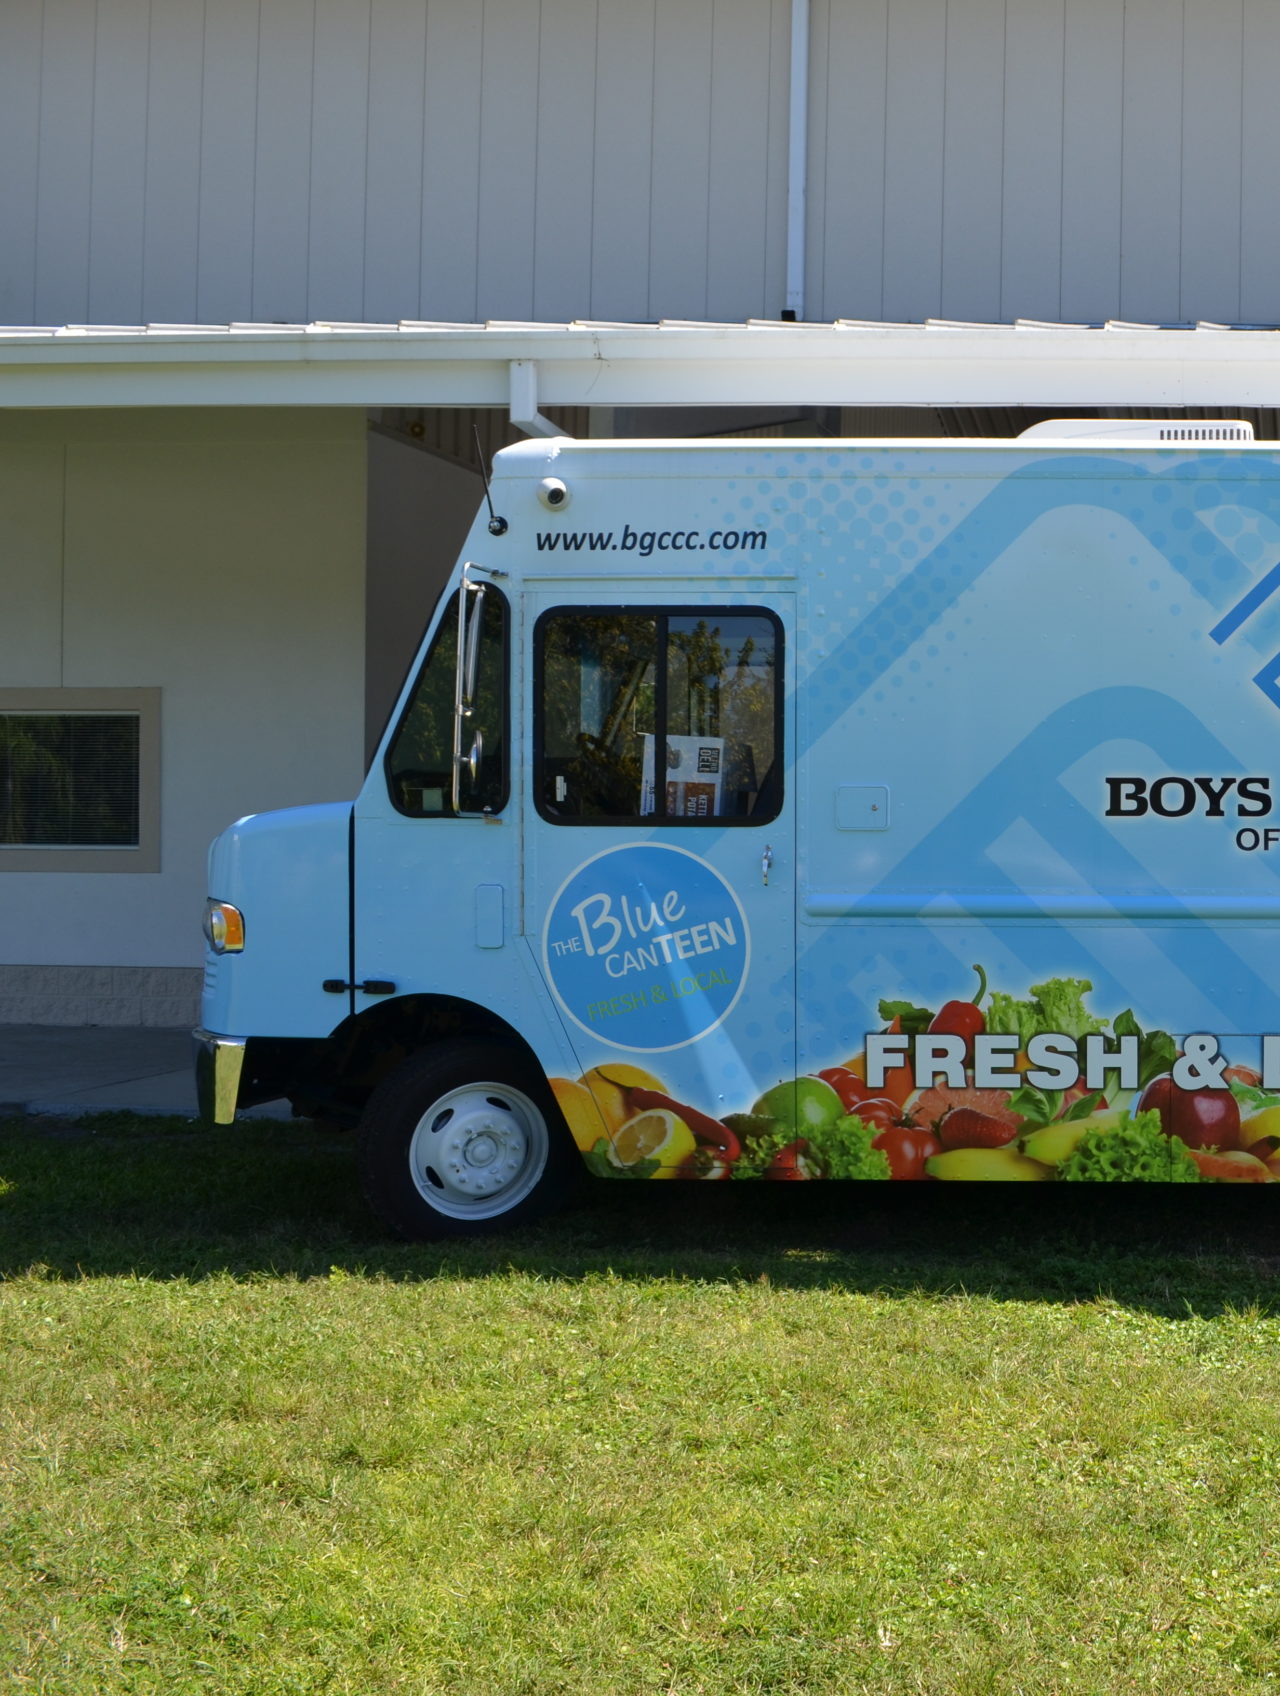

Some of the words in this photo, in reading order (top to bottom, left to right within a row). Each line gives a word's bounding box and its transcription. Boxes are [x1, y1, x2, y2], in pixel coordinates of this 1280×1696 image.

[536, 525, 767, 556] www.bgccc.com
[699, 748, 711, 771] DELI
[1105, 777, 1272, 817] BOYS
[1235, 828, 1280, 851] OF
[552, 937, 582, 957] THE
[571, 890, 686, 957] Blue
[605, 917, 737, 978] CANTEEN
[587, 991, 646, 1021] FRESH
[651, 985, 668, 1002] &
[671, 967, 734, 998] LOCAL
[866, 1034, 1139, 1088] FRESH
[1172, 1034, 1228, 1090] &
